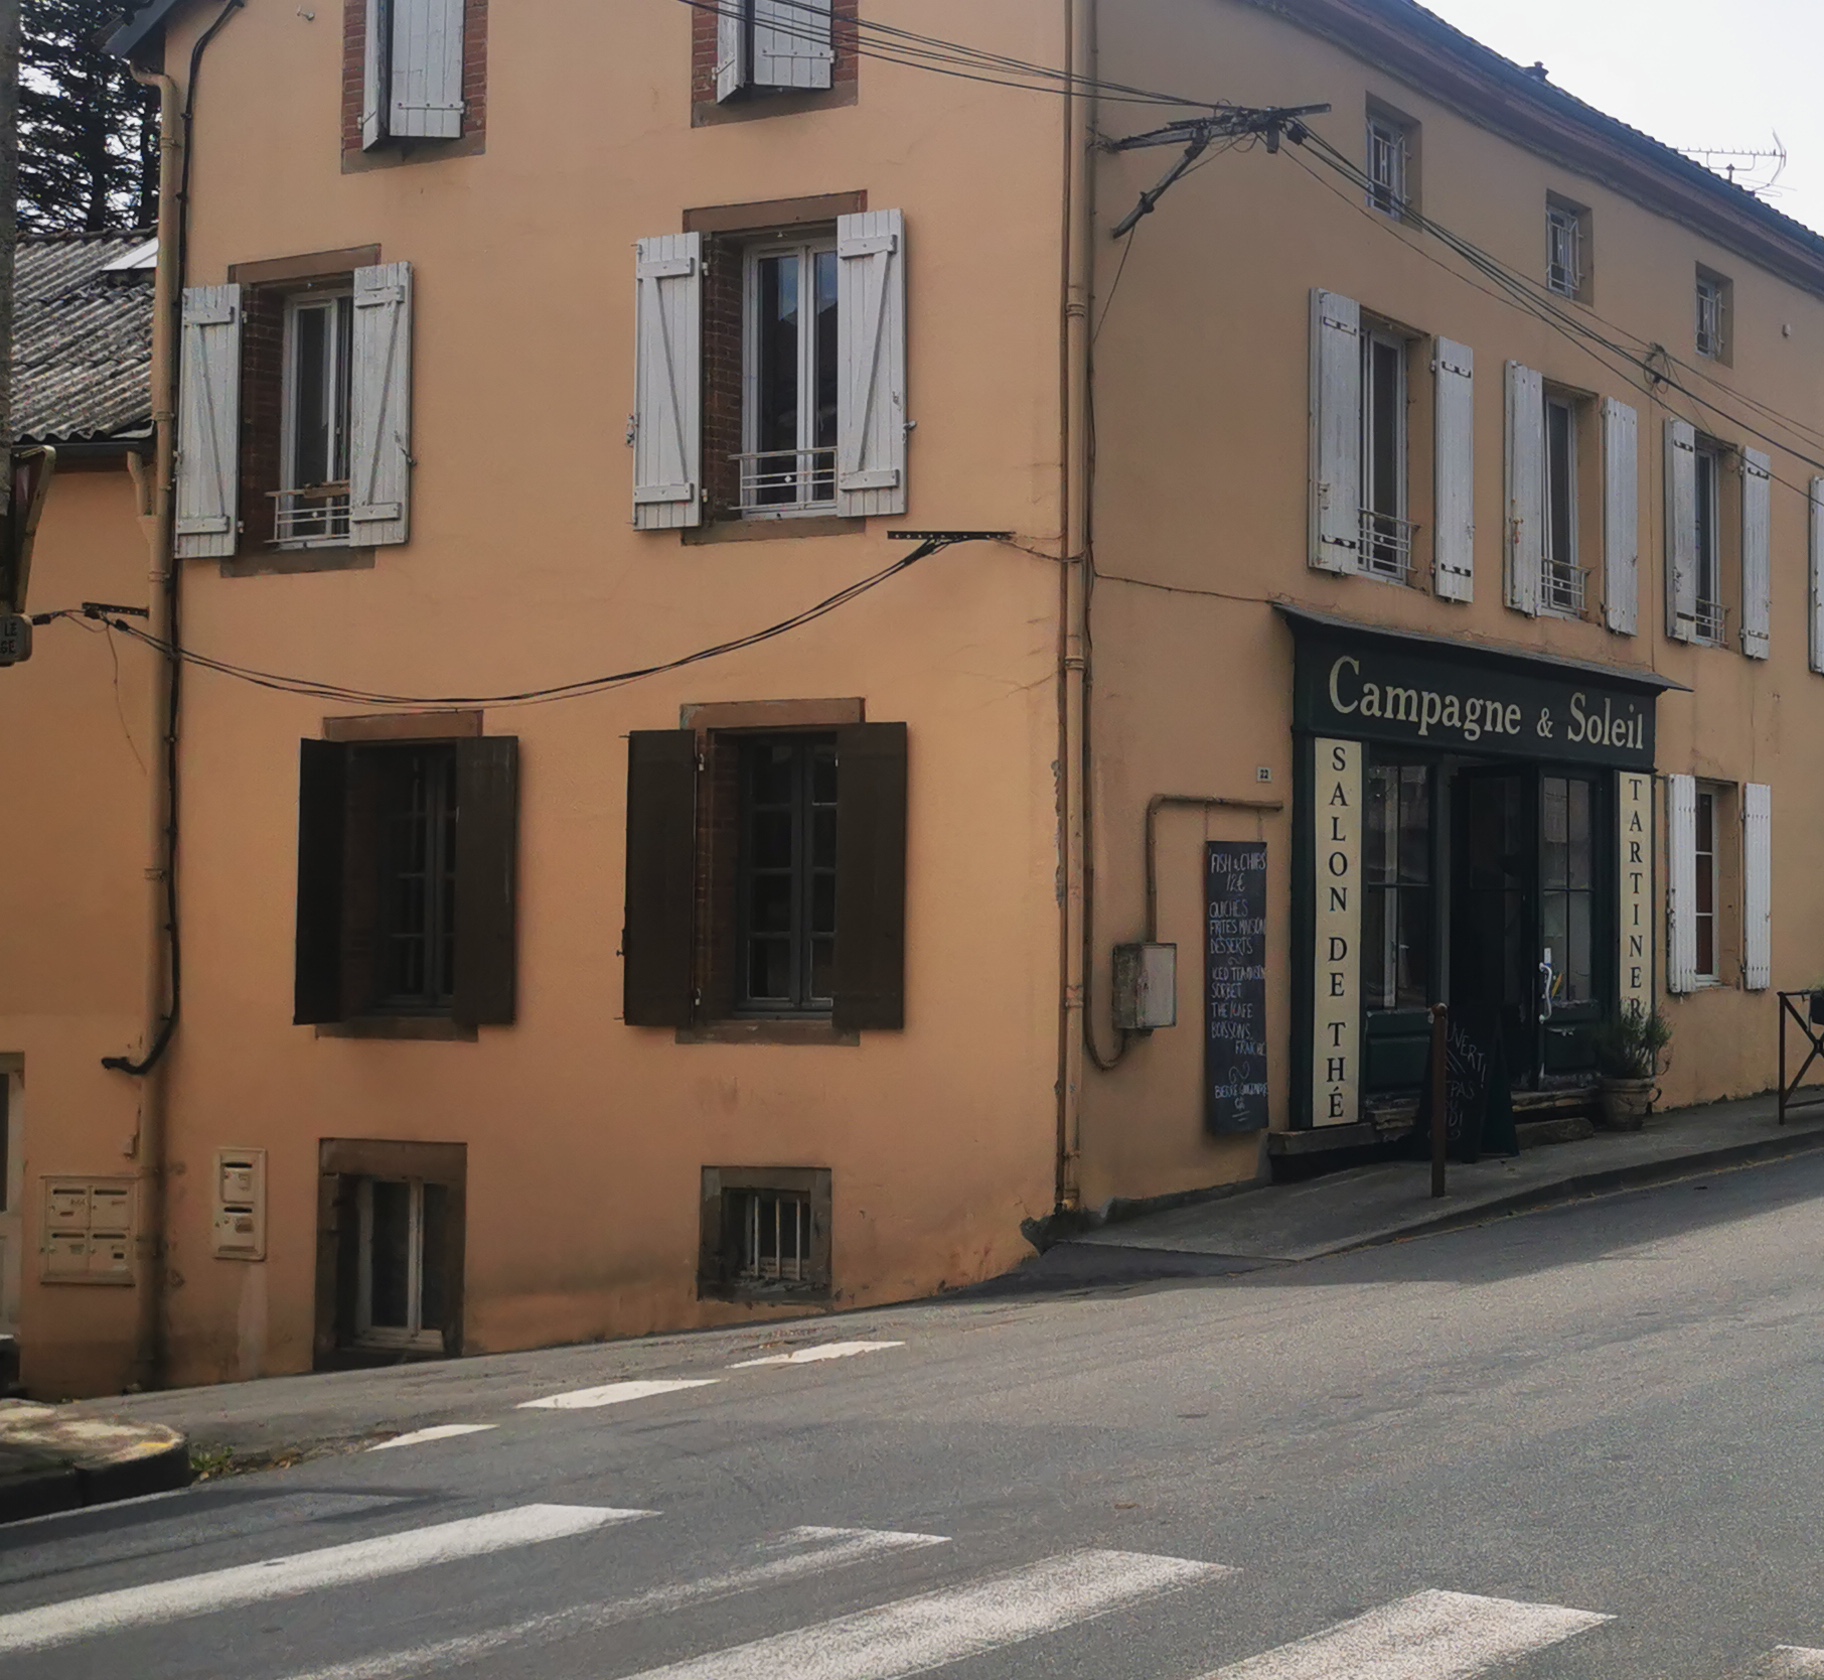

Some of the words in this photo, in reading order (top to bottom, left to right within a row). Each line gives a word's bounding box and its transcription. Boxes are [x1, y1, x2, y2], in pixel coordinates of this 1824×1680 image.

[1329, 655, 1522, 741] Campagne
[1536, 708, 1554, 738] &
[1567, 692, 1644, 749] Soleil
[1211, 853, 1231, 873] FISH
[1328, 745, 1349, 913] SALON
[1327, 936, 1348, 997] DE
[1325, 1021, 1346, 1119] THÉ
